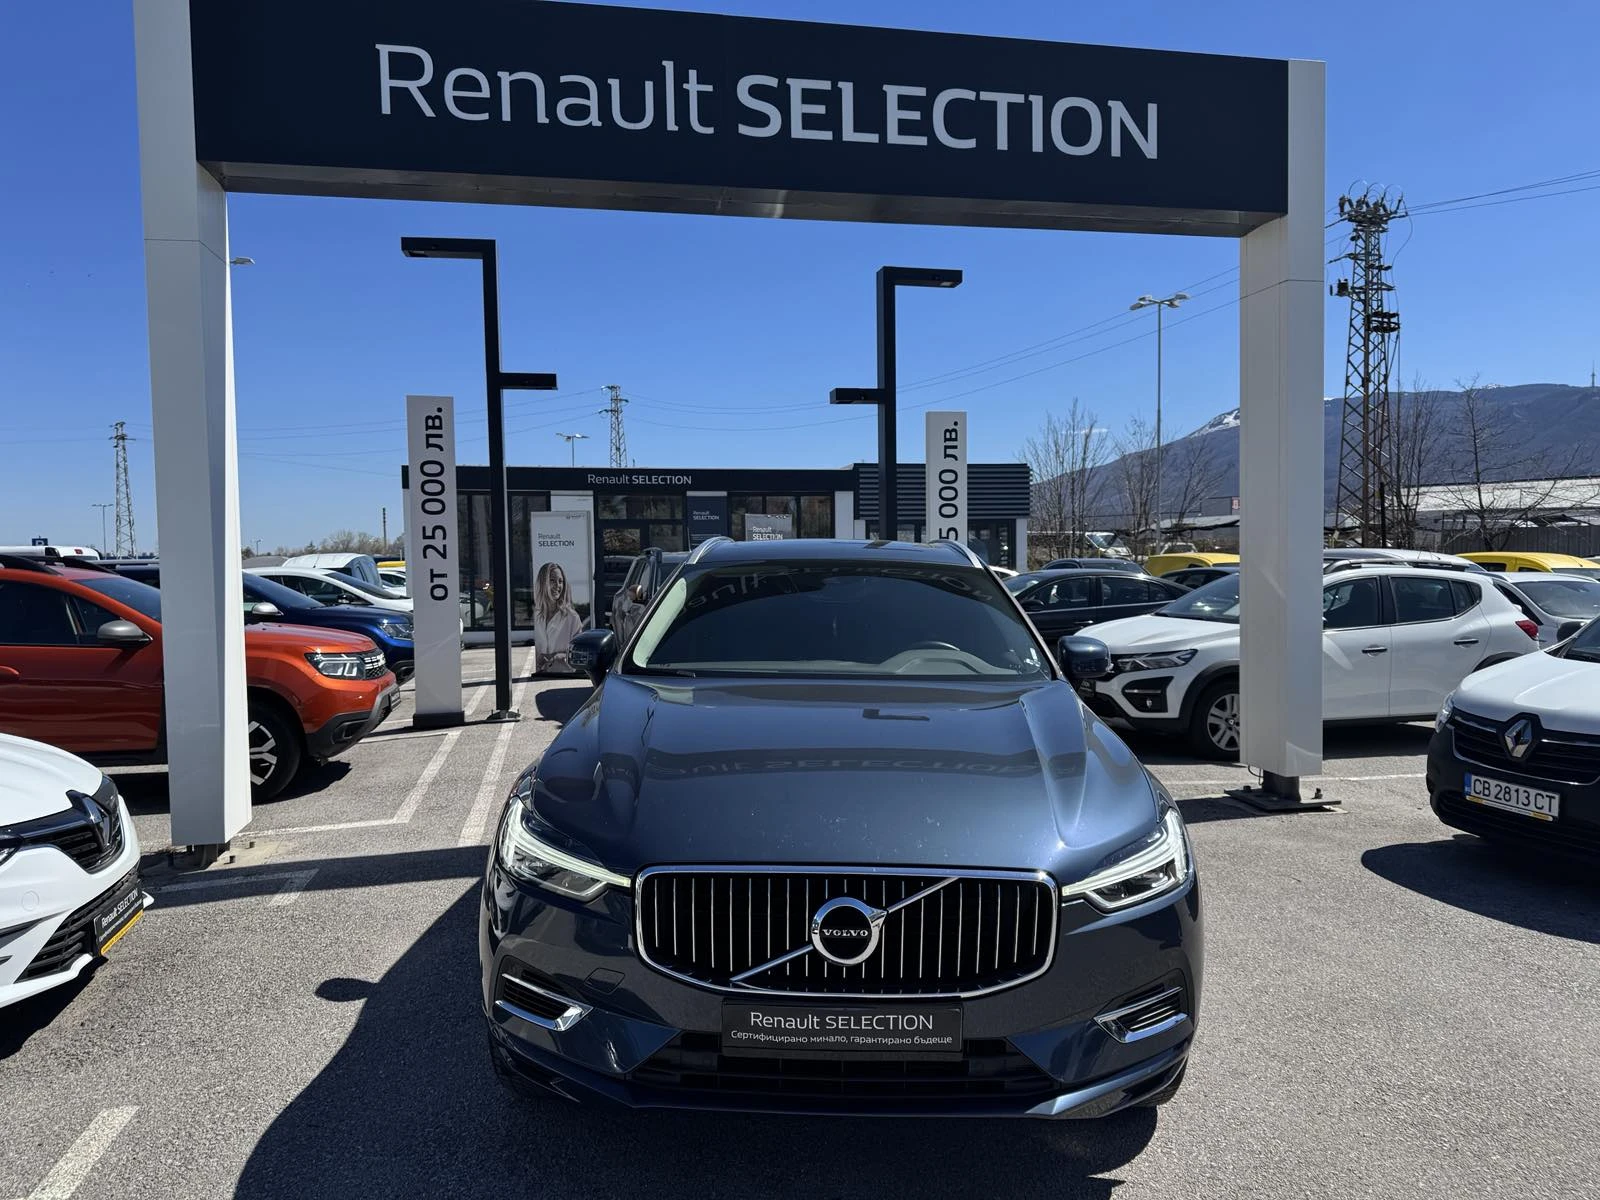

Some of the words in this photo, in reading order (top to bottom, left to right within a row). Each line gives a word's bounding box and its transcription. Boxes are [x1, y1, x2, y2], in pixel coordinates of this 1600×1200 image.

[375, 43, 715, 135] Renault
[736, 74, 1158, 159] SELECTION
[425, 407, 443, 452] лв.
[943, 420, 959, 462] лв.
[419, 459, 446, 516] 000
[587, 474, 630, 485] Renault
[632, 475, 692, 485] SELECTION
[938, 468, 958, 519] 000
[423, 525, 447, 560] 25
[752, 533, 784, 541] SELECTION
[430, 568, 448, 601] от
[101, 907, 118, 928] Renault
[117, 888, 138, 914] SELECTION
[822, 928, 869, 937] VOLVO
[730, 1030, 808, 1044] Сертифицирано
[810, 1034, 849, 1044] минало,
[850, 1036, 912, 1045] гарантирано
[913, 1035, 953, 1045] бъдеще
[750, 1011, 821, 1030] Renault
[825, 1014, 933, 1030] SELECTION
